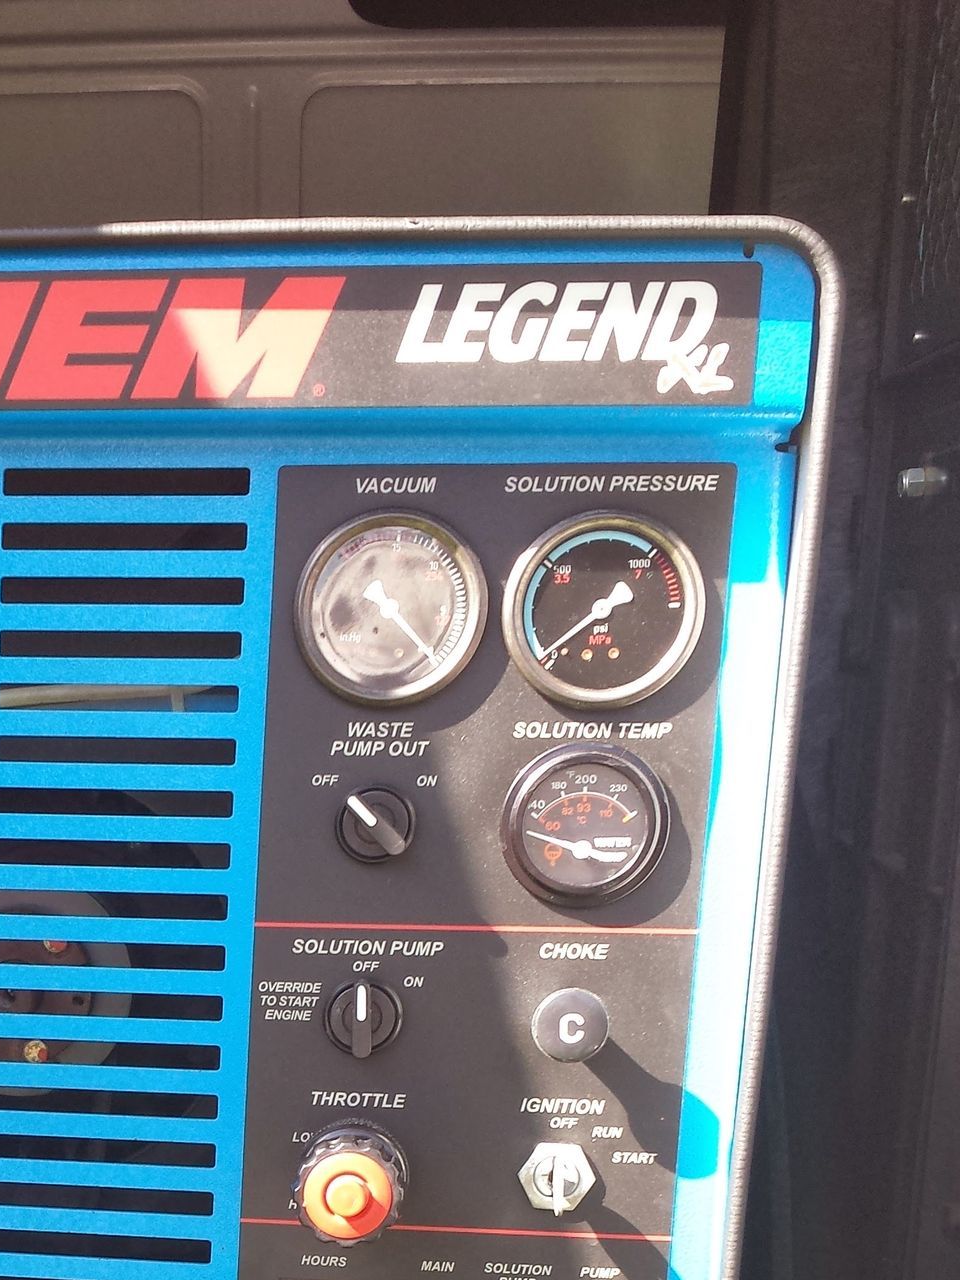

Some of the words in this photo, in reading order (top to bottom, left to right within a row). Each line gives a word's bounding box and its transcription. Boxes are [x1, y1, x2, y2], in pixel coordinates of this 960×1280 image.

[394, 281, 719, 364] LEGEND
[356, 477, 436, 493] VACUUM
[504, 475, 605, 492] SOLUTION
[608, 474, 719, 491] PRESSURE
[429, 560, 439, 571] 10
[553, 564, 572, 575] 500
[628, 558, 650, 569] 1000
[554, 574, 570, 584] 3.5
[593, 623, 609, 635] psi
[589, 635, 612, 645] MPa
[348, 721, 414, 737] WASTE
[512, 721, 616, 738] SOLUTION
[617, 721, 672, 739] TEMP
[330, 740, 385, 756] PUMP
[388, 740, 430, 756] OUT
[311, 774, 339, 786] OFF
[416, 775, 437, 786] ON
[575, 775, 597, 784] 200
[552, 782, 567, 790] 180
[610, 785, 627, 793] 230
[292, 938, 386, 955] SOLUTION
[389, 940, 444, 956] PUMP
[539, 942, 609, 960] CHOKE
[352, 960, 380, 972] OFF
[258, 981, 322, 993] OVERRIDE
[403, 976, 424, 987] ON
[260, 995, 276, 1006] TO
[278, 995, 319, 1007] START
[264, 1009, 312, 1020] ENGINE
[559, 1013, 585, 1044] C
[311, 1091, 406, 1108] THROTTLE
[520, 1096, 605, 1115] IGNITION
[548, 1116, 579, 1129] OFF
[591, 1125, 623, 1138] RUN
[292, 1132, 313, 1144] LO
[611, 1151, 658, 1164] START
[301, 1254, 347, 1267] HOURS
[420, 1260, 455, 1272] MAIN
[484, 1262, 552, 1275] SOLUTION
[578, 1266, 620, 1279] PUMP
